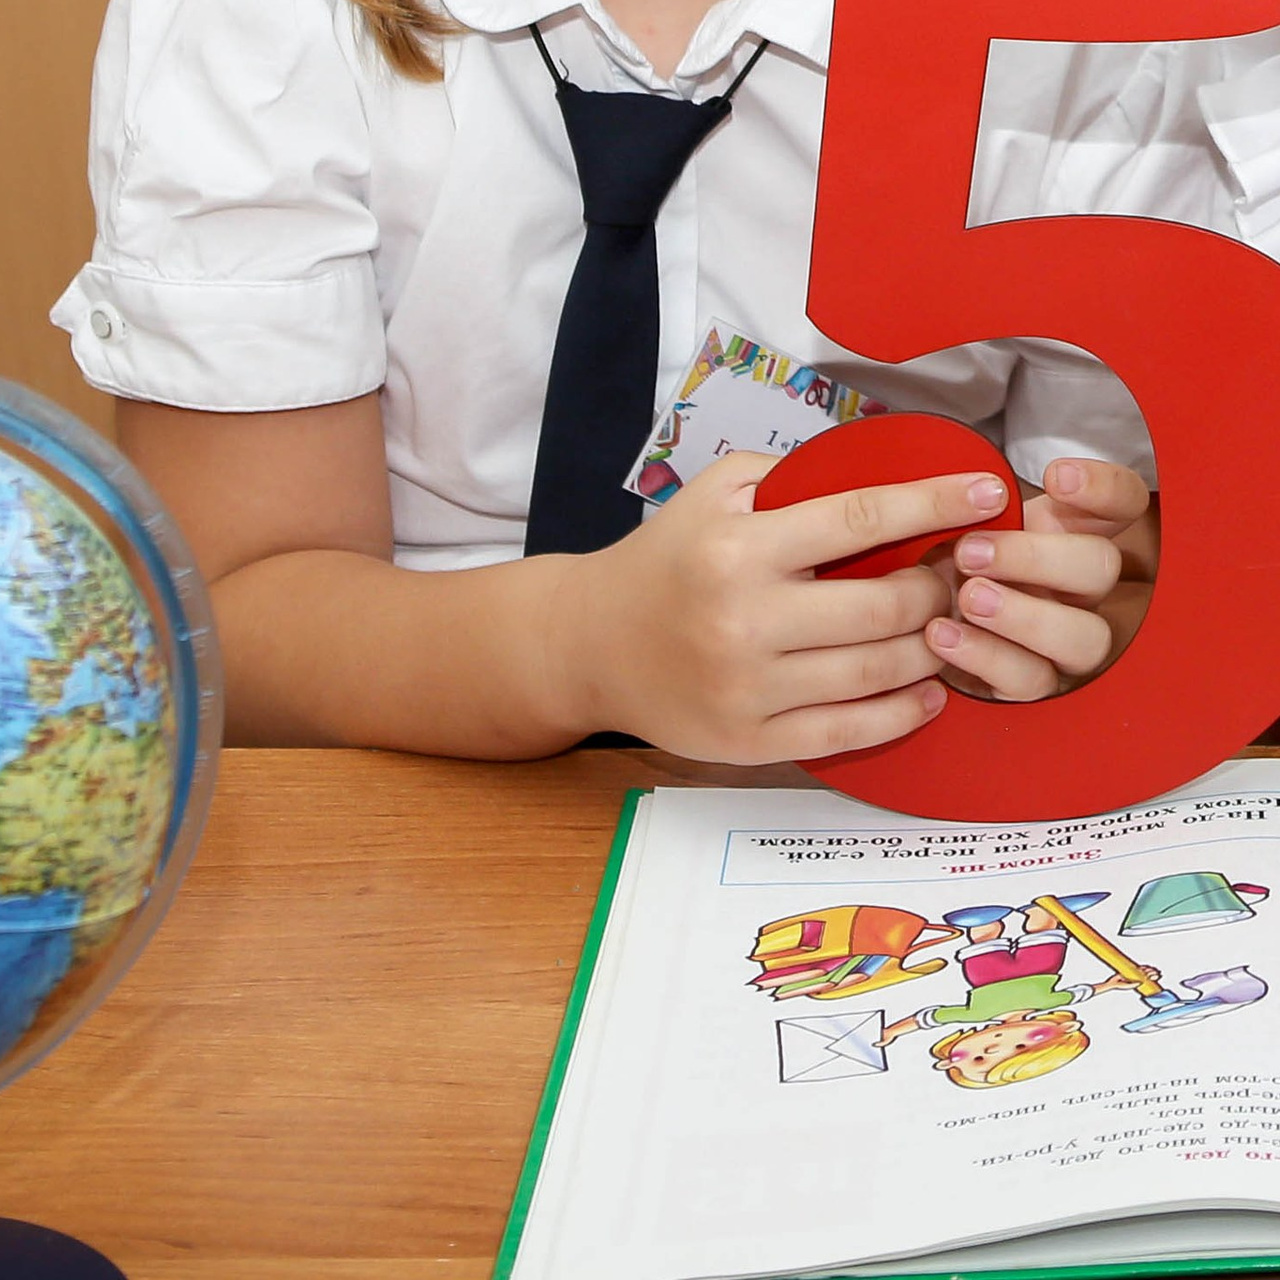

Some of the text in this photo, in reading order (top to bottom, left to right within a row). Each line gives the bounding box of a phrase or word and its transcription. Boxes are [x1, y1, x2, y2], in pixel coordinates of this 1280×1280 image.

[1046, 806, 1176, 834] хо-ро-шо
[749, 836, 902, 846] бо-си-ком.
[777, 808, 1266, 863] На-до мыть ру-ки пе-ред е-дой.
[918, 831, 1030, 843] хо-дить
[939, 848, 1101, 874] За-пом-ни.
[1060, 1077, 1198, 1105] на-пи-сать
[1102, 1093, 1178, 1111] пыль.
[1148, 1106, 1203, 1117] пол.
[934, 1103, 1046, 1128] пись-мо.
[1092, 1121, 1204, 1142] сде-лать
[971, 1138, 1078, 1167] у-ро-ки.
[1117, 1136, 1206, 1154] мно-го
[1175, 1149, 1230, 1160] дел.
[1049, 1149, 1103, 1166] дел.
